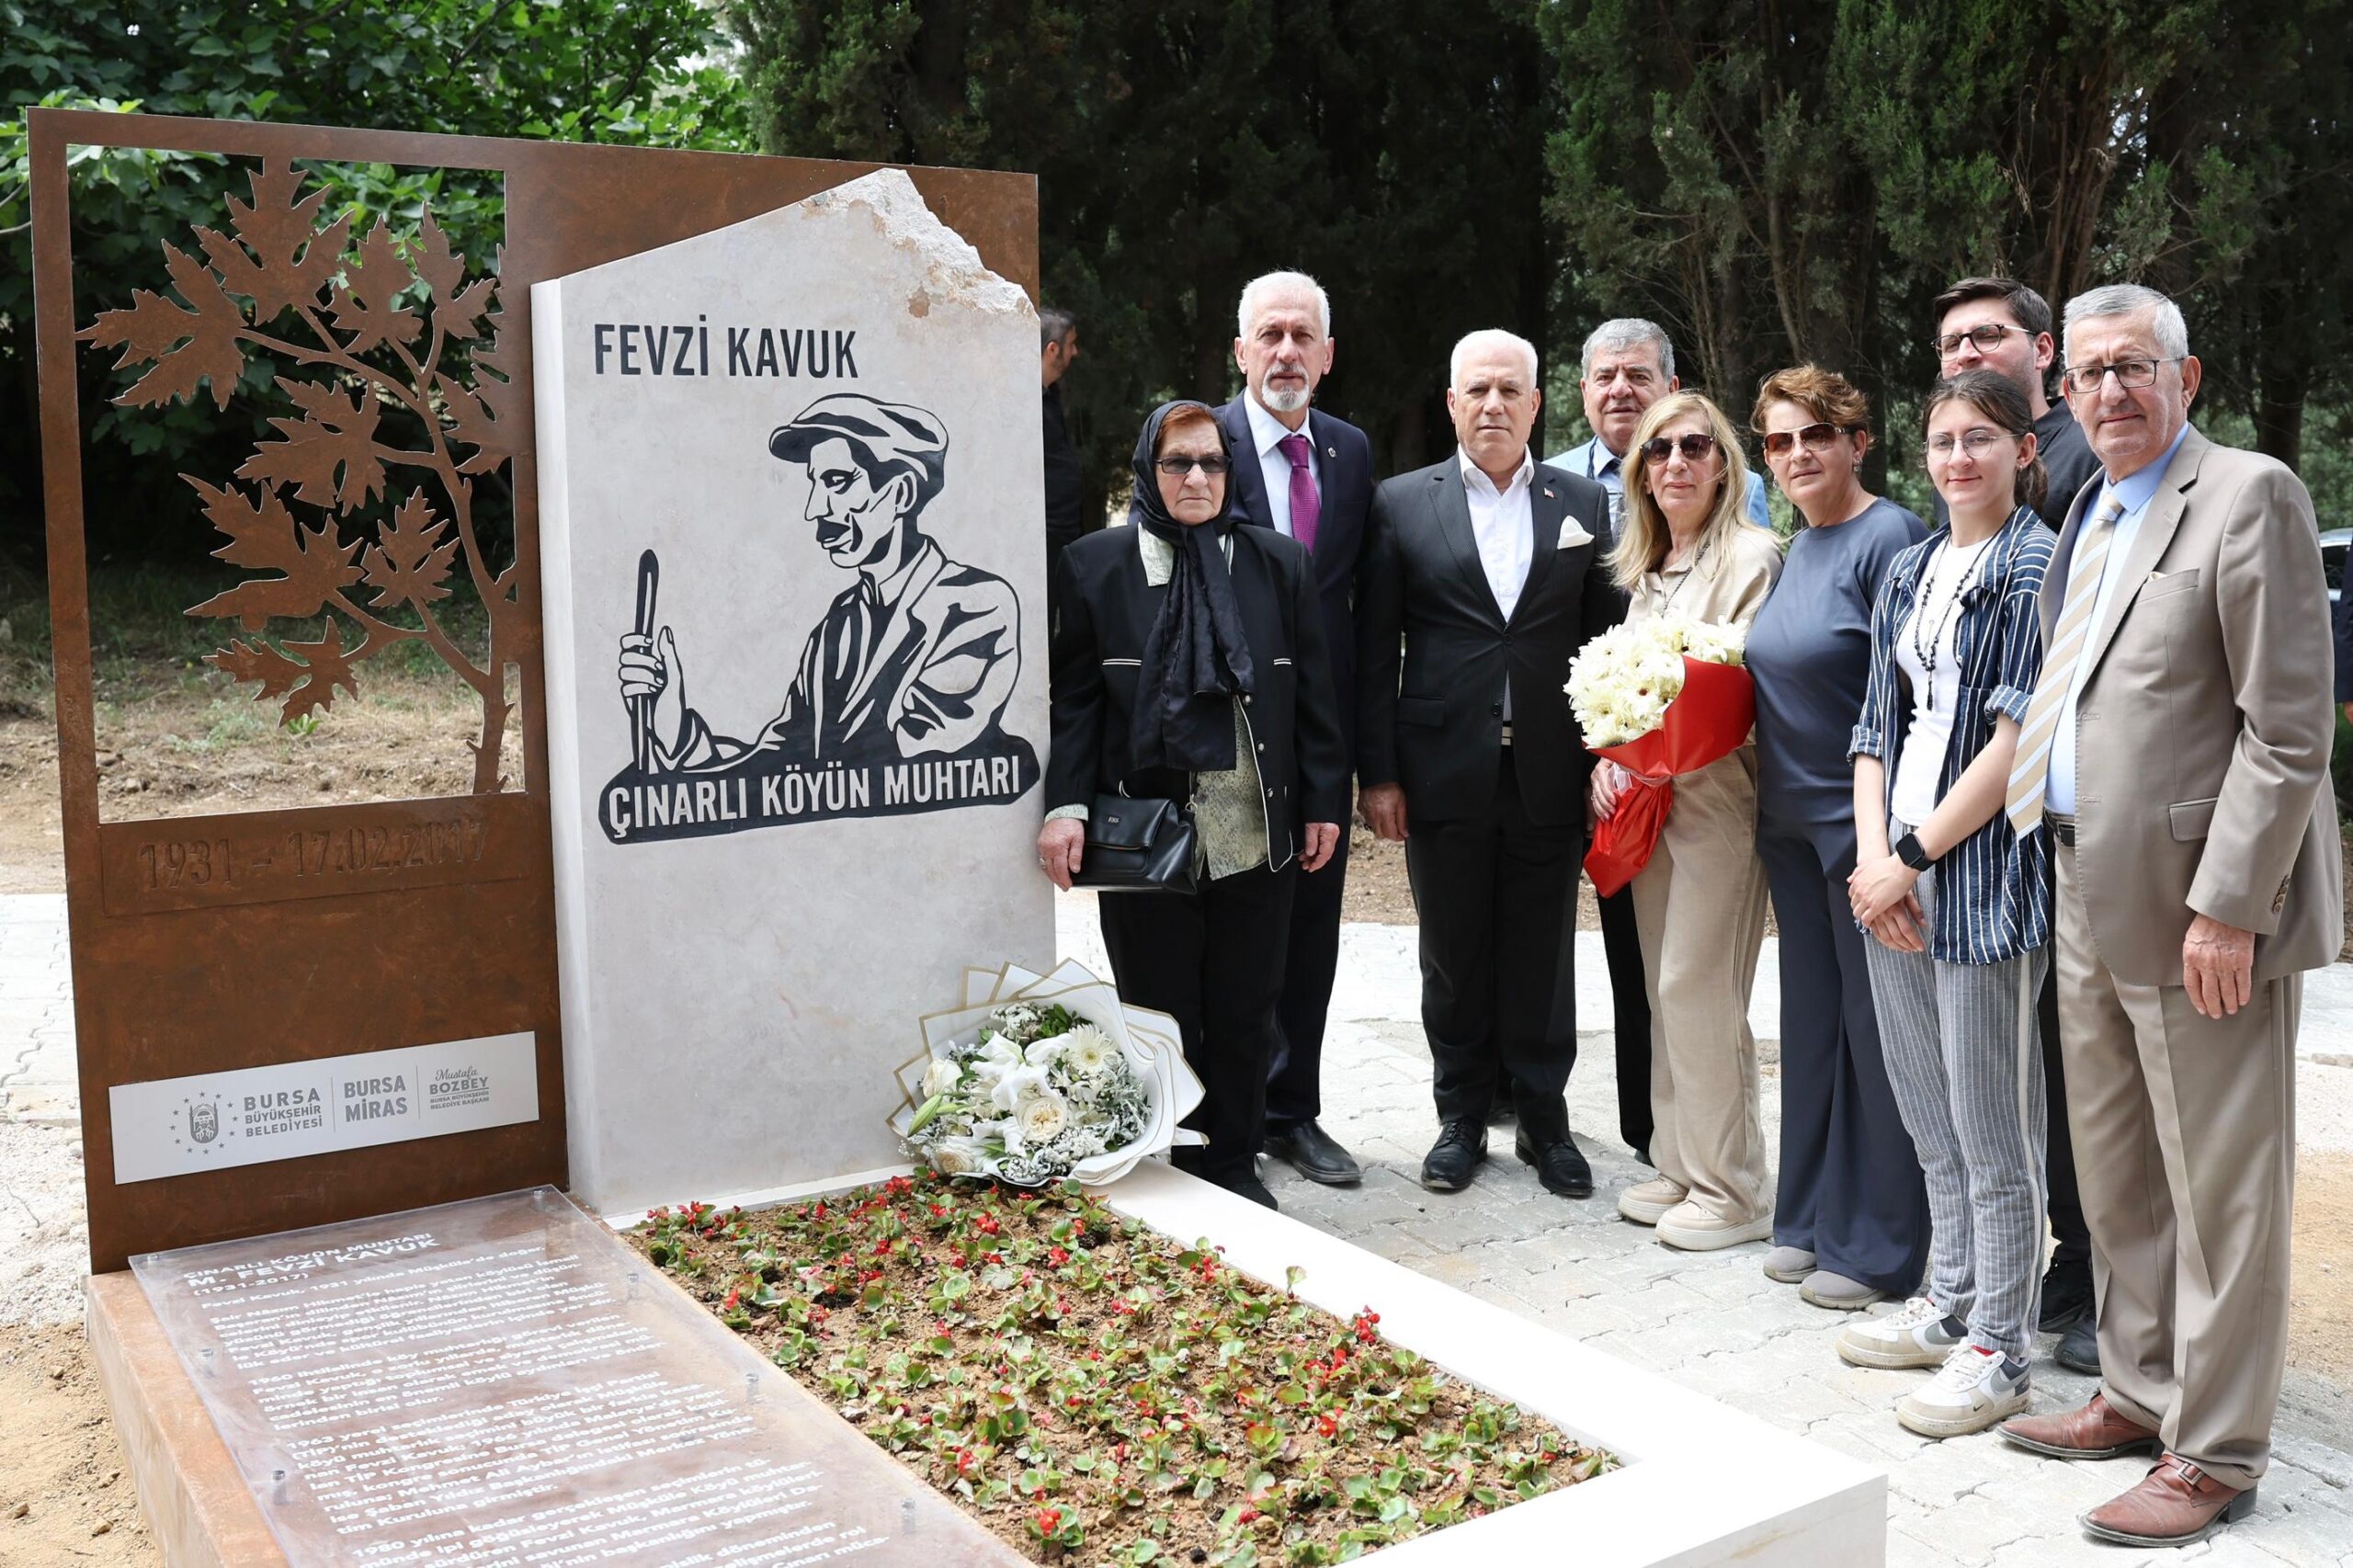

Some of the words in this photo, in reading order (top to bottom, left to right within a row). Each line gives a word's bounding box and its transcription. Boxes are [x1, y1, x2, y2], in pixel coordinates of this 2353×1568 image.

[595, 313, 709, 376] FEVZİ
[728, 327, 858, 378] KAVUK
[608, 778, 747, 838] ÇINARLI
[761, 761, 870, 816] KÖYÜN
[883, 756, 1019, 806] MUHTARI
[141, 838, 232, 890] 1931
[435, 1065, 479, 1082] Mustafa
[344, 1075, 406, 1098] BURSA
[429, 1076, 489, 1095] BOZBEY
[244, 1087, 321, 1111] BURSA
[346, 1096, 408, 1122] MİRAS
[244, 1103, 322, 1124] BÜYÜKŞEHİR
[245, 1115, 323, 1137] BELEDİYESİ
[183, 1261, 263, 1280] ÇINARLI
[269, 1248, 340, 1265] KÖYÜN
[346, 1233, 431, 1252] MUHTARI
[187, 1276, 226, 1287] M.
[236, 1256, 325, 1278] FEVZİ
[334, 1238, 439, 1262] KAVUK
[193, 1272, 308, 1295] (1931-2017)
[200, 1297, 245, 1309] Fevzi
[249, 1289, 305, 1301] Kavuk,
[309, 1280, 347, 1290] 1931
[247, 1373, 293, 1385] 1960
[252, 1381, 301, 1394] Fevzi
[578, 1403, 604, 1414] bir
[286, 1435, 334, 1449] 1963
[344, 1456, 396, 1471] Fevzi
[470, 1432, 517, 1446] 1966
[494, 1438, 547, 1453] Bursa
[328, 1513, 359, 1523] ise
[635, 1437, 705, 1458] Merkez
[485, 1467, 511, 1479] Ali
[435, 1540, 463, 1553] ipi
[689, 1477, 740, 1494] Köyü
[519, 1529, 574, 1548] Fevzi
[577, 1515, 646, 1535] Kavuk,
[649, 1493, 737, 1517] Marmara
[524, 1538, 608, 1562] savunan
[609, 1515, 700, 1540] Marmara
[789, 1484, 823, 1495] Da-
[335, 1523, 372, 1534] tim
[351, 1540, 404, 1557] 1980
[467, 1515, 526, 1533] kadar
[838, 1525, 867, 1539] rol
[833, 1536, 889, 1555] müca-
